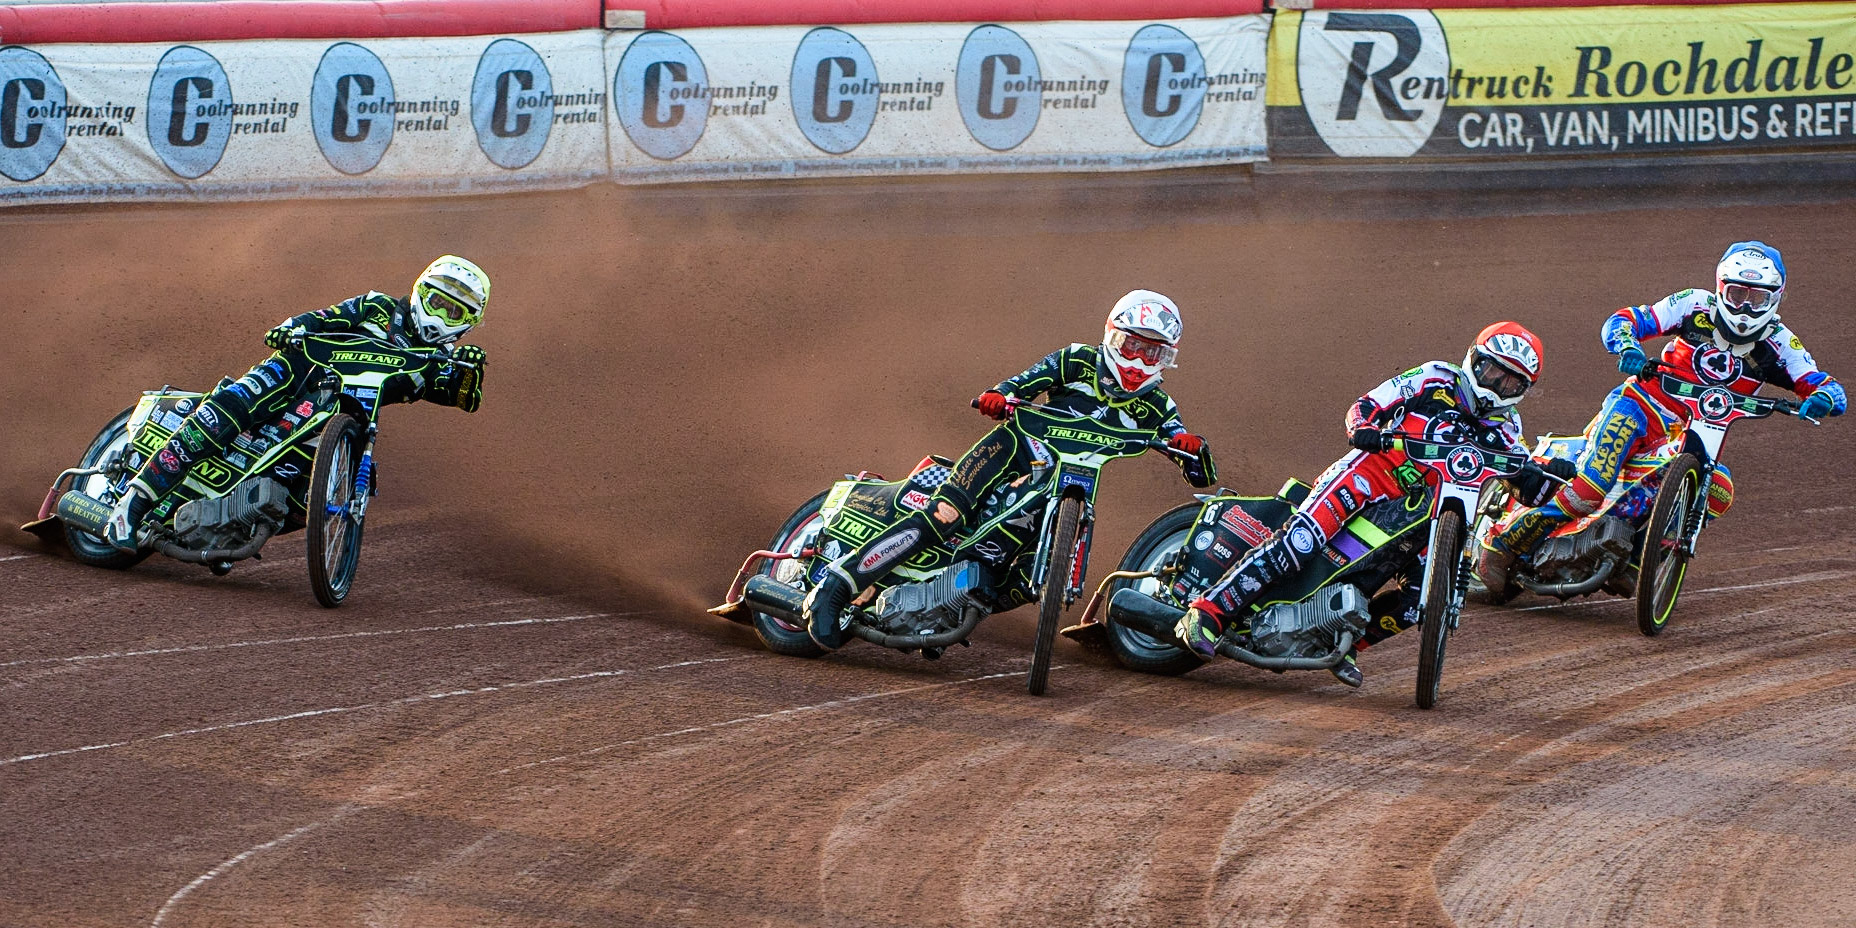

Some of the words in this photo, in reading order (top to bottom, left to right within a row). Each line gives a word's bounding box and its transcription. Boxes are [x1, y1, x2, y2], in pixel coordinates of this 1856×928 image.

[1566, 37, 1854, 97] Rochdale
[711, 101, 767, 117] rental
[881, 96, 933, 112] rental
[1042, 94, 1097, 109] rental
[67, 122, 124, 138] rental
[232, 118, 287, 135] rental
[397, 114, 449, 132] rental
[1458, 111, 1534, 153] CAR,
[1540, 110, 1619, 151] VAN,
[1627, 104, 1759, 144] MINIBUS
[1766, 103, 1789, 138] &
[335, 352, 358, 361] TRU
[359, 354, 402, 365] PLANT
[1051, 428, 1077, 438] TRU
[1076, 432, 1120, 447] PLANT
[1590, 412, 1626, 472] KEVIN
[1600, 416, 1638, 483] MOORE
[904, 491, 929, 507] NGK
[1340, 488, 1356, 510] BOSS
[92, 503, 113, 517] YOUN
[1203, 504, 1219, 524] 6
[839, 516, 872, 540] TRU
[863, 553, 882, 569] KMA
[880, 533, 913, 557] FORKLIFTS
[1213, 542, 1233, 559] BOSS
